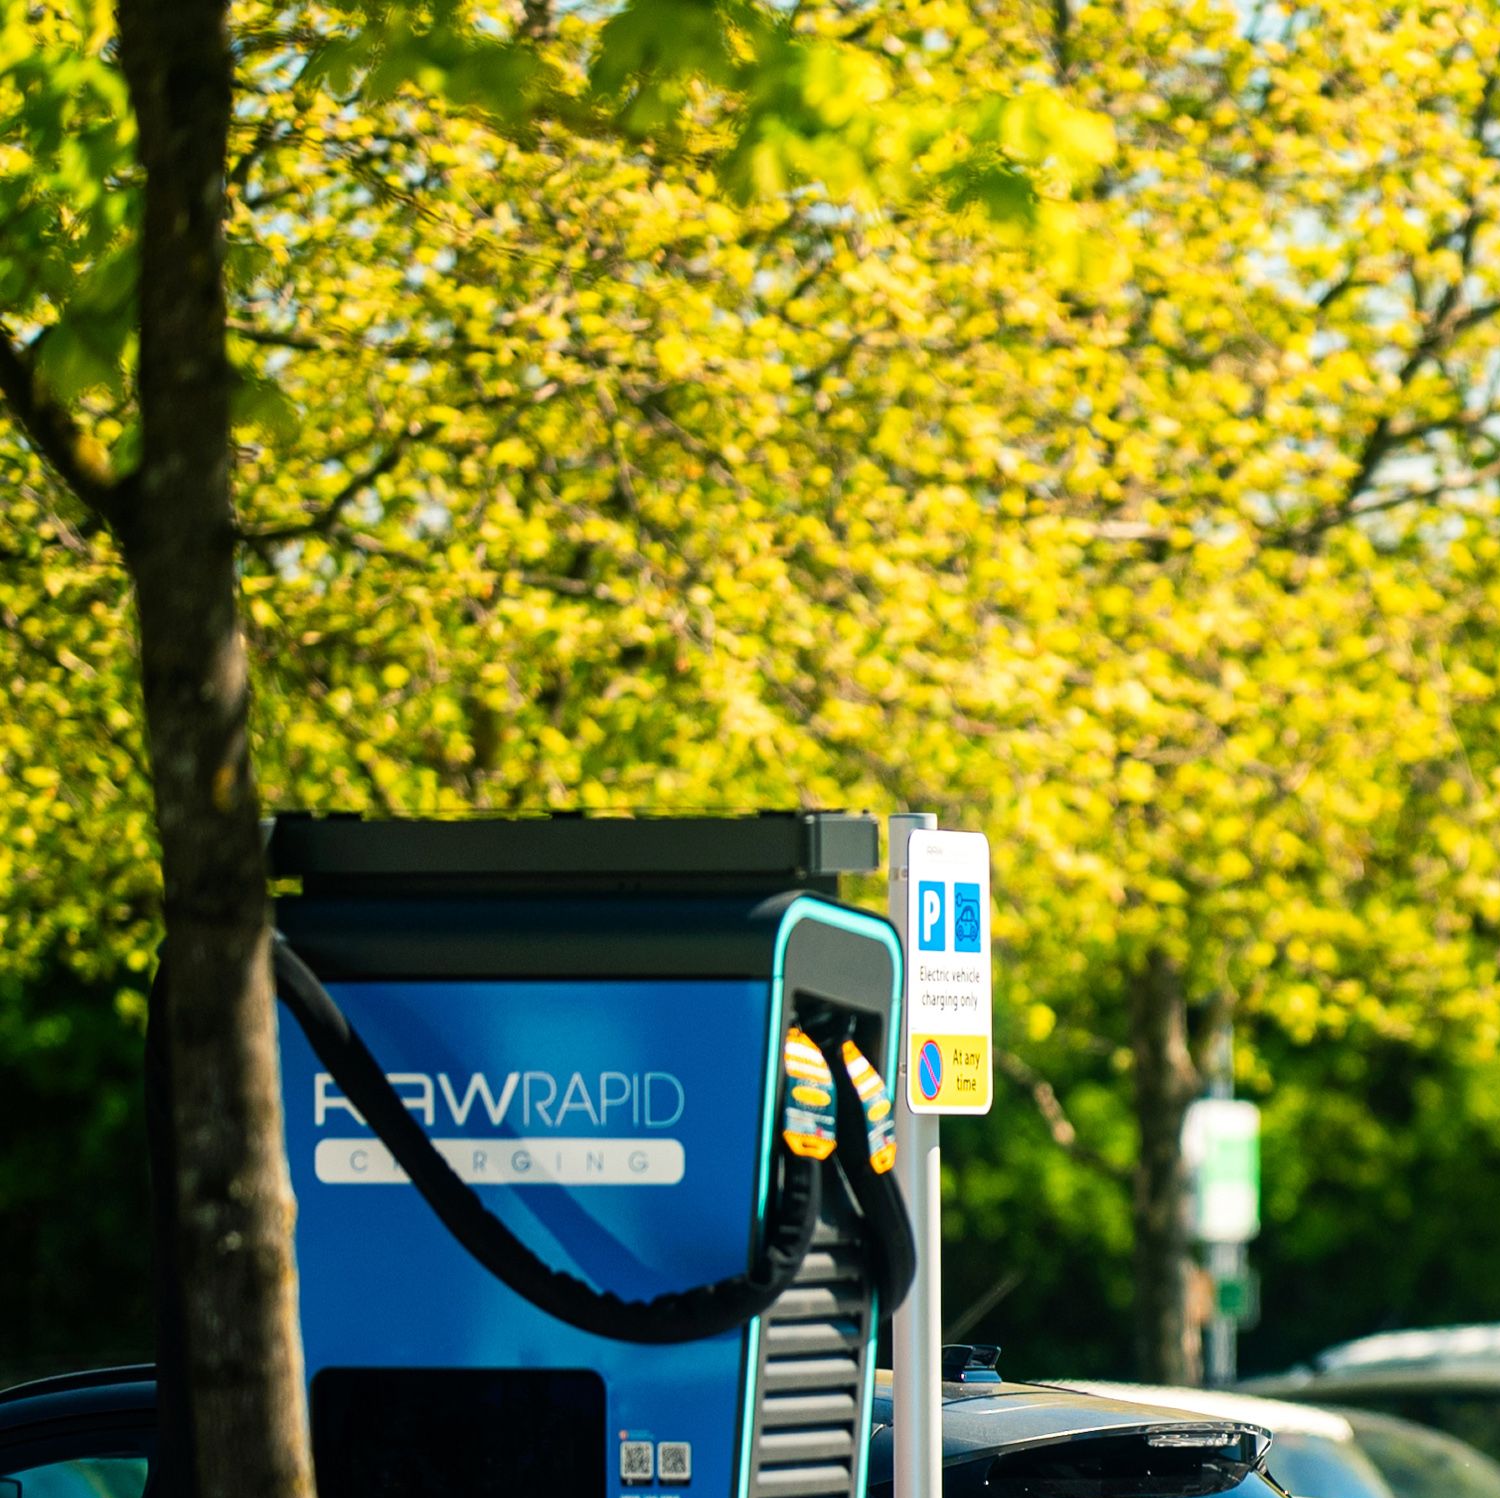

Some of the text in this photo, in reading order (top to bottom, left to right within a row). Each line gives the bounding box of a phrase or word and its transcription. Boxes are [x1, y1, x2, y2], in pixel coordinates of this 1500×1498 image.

[923, 889, 941, 942] P
[920, 965, 980, 983] Electric vehicle
[922, 989, 978, 1012] charging only
[953, 1048, 981, 1071] At any
[956, 1072, 977, 1092] time
[350, 1149, 649, 1174] CRGING
